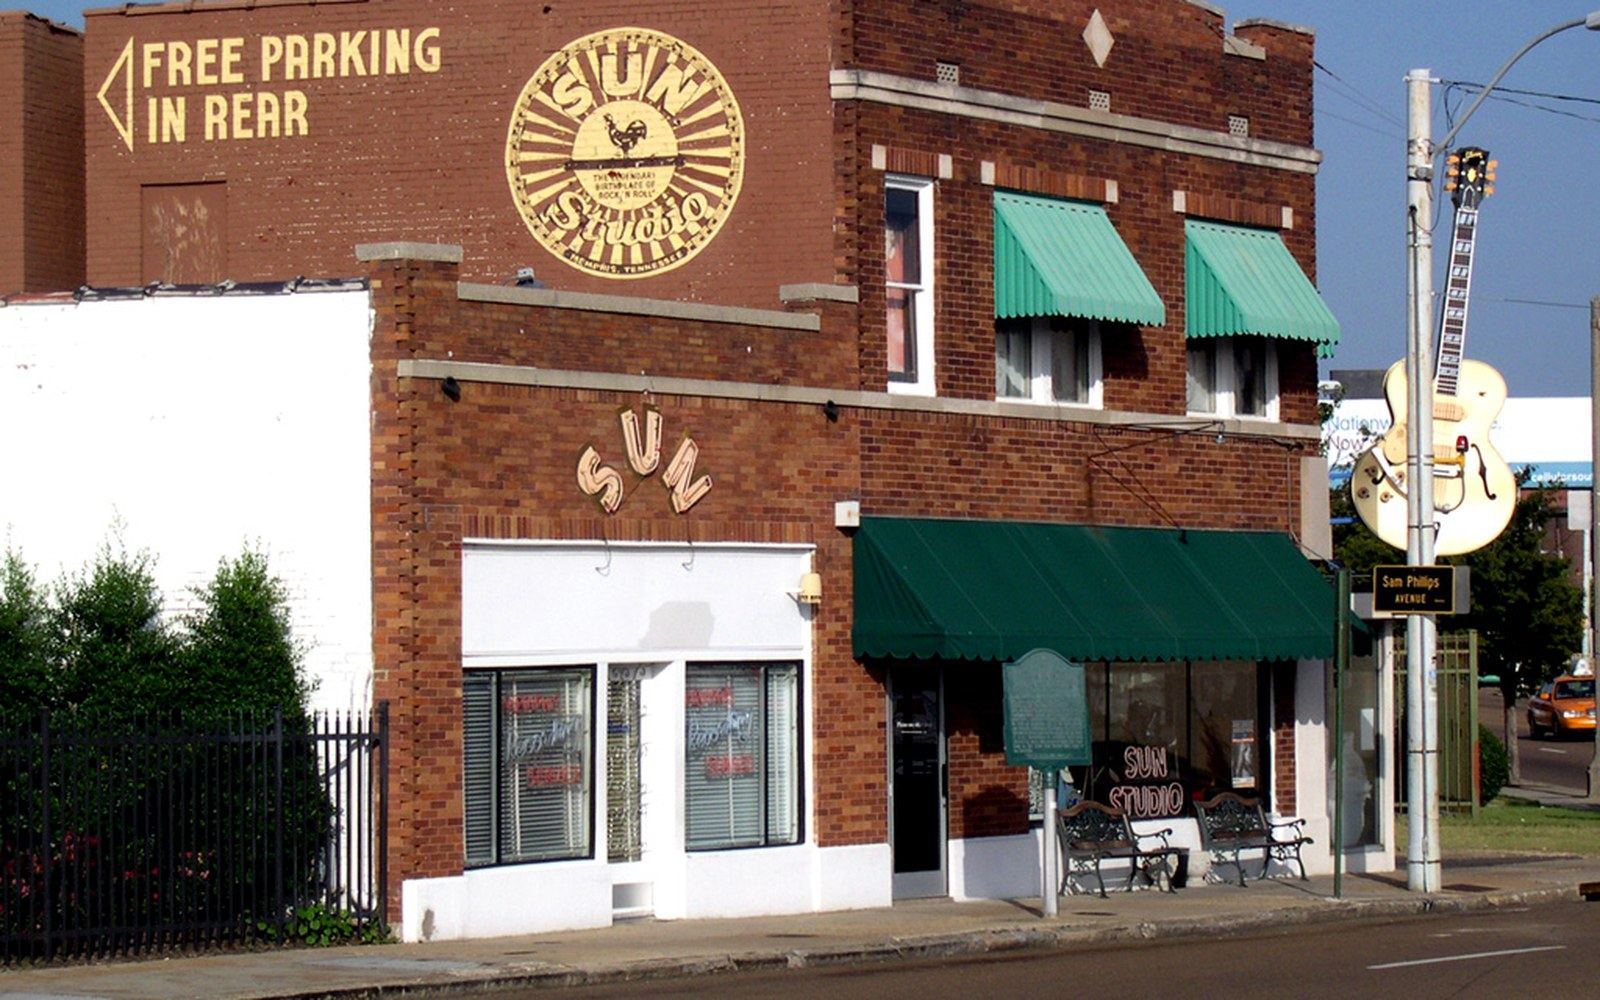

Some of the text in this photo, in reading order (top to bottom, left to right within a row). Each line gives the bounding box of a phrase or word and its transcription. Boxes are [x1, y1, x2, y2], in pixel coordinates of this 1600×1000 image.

[143, 27, 442, 88] FREE PARKING
[552, 51, 700, 117] SUN
[148, 89, 309, 144] IN REAR
[593, 171, 656, 182] THE GENDARY
[595, 180, 656, 191] BIRTHPLACE OF
[543, 191, 708, 246] Studio
[623, 251, 686, 274] TENNESSEE
[1327, 415, 1390, 432] Nationw
[577, 408, 713, 514] SUN
[1382, 575, 1441, 591] Sam Phillips
[1395, 593, 1427, 604] AVENUE
[1124, 745, 1168, 779] SUN
[1109, 782, 1184, 818] STUDIO
